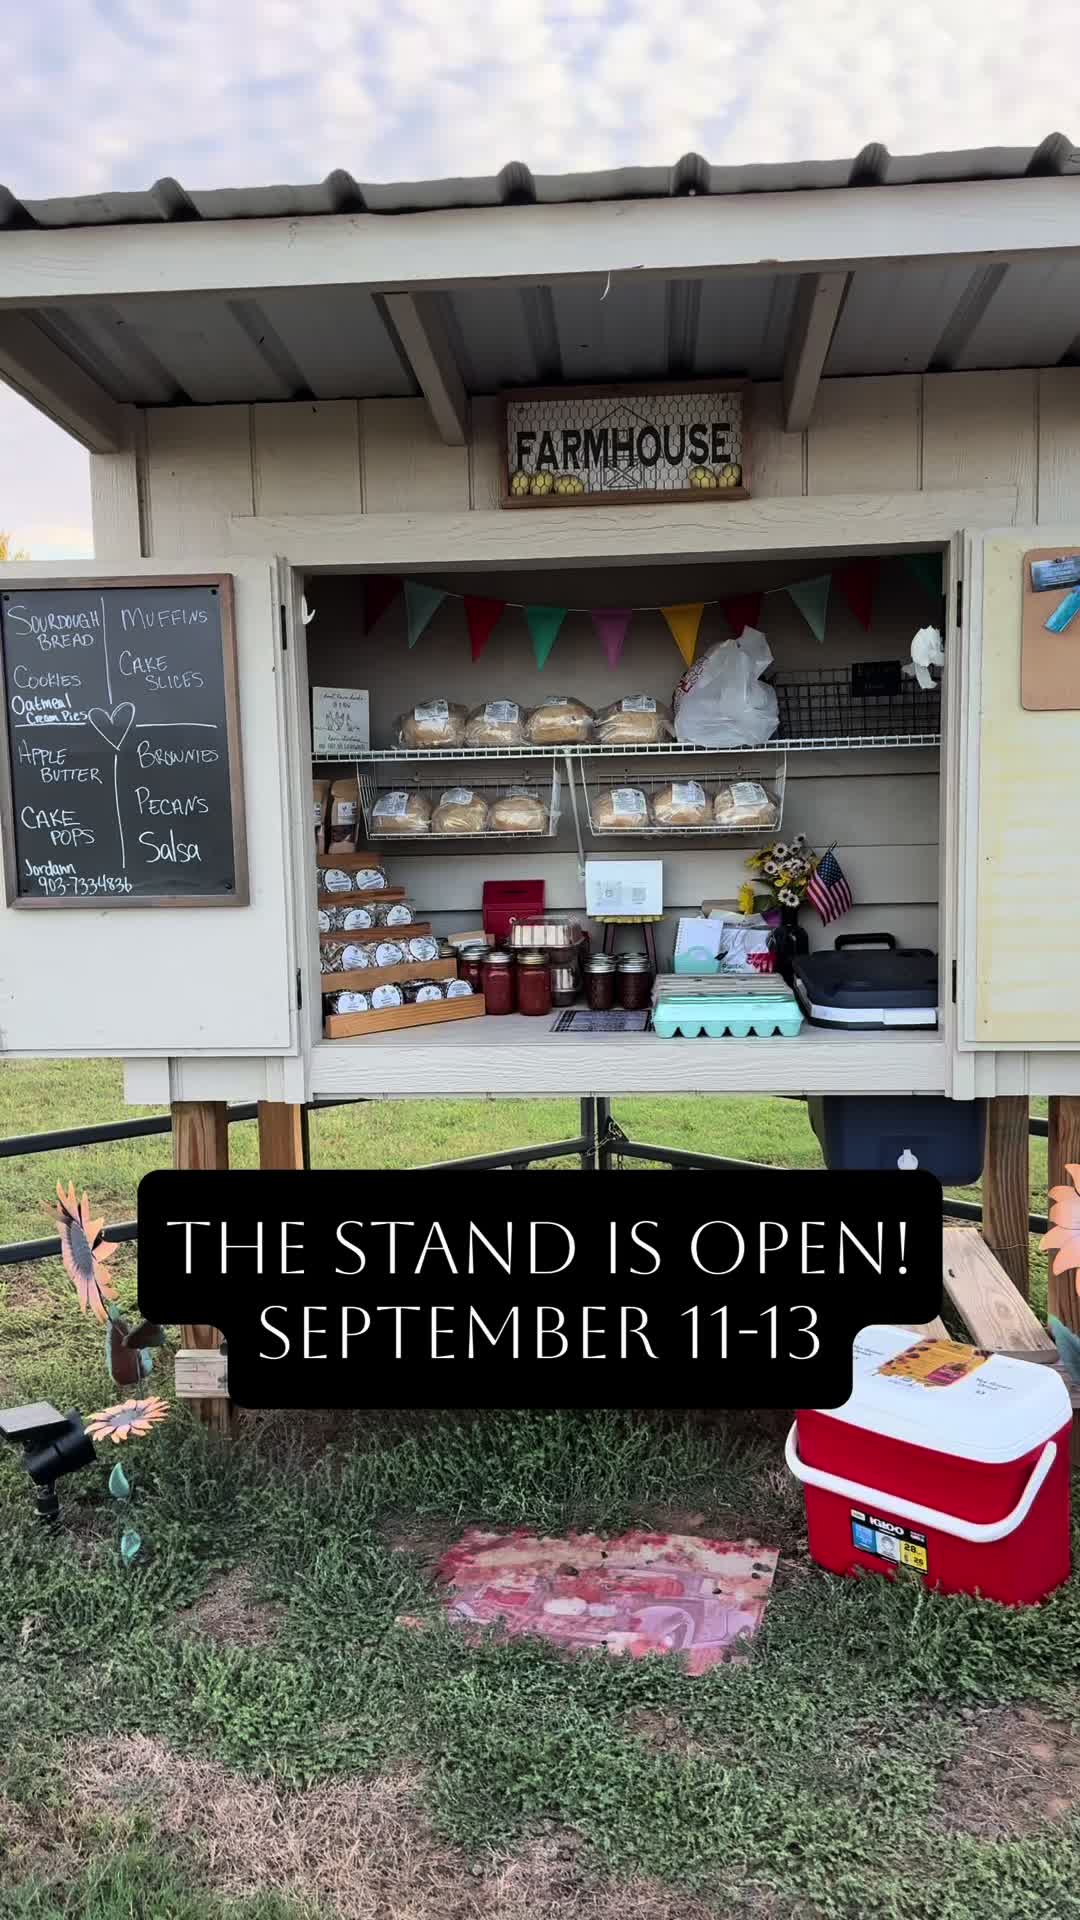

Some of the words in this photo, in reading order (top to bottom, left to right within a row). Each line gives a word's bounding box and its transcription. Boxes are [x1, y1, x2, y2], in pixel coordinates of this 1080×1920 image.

[516, 422, 732, 472] FARMHOUSE
[7, 605, 101, 636] SOURDOUGH
[121, 608, 209, 631] MUFFINS
[37, 633, 94, 651] BREAD
[118, 650, 169, 676] CAKE
[13, 665, 82, 689] COOKIES
[145, 671, 204, 690] SLICES
[11, 692, 72, 715] Oatmeal
[61, 710, 89, 722] Pies
[18, 739, 69, 765] APPLE
[136, 740, 219, 769] BROWNIES
[41, 766, 104, 785] BUTTER
[135, 786, 210, 816] PECANS
[21, 806, 81, 829] CAKE
[50, 828, 96, 847] POPS
[138, 829, 203, 863] Salsa
[38, 873, 134, 896] 903-7334836
